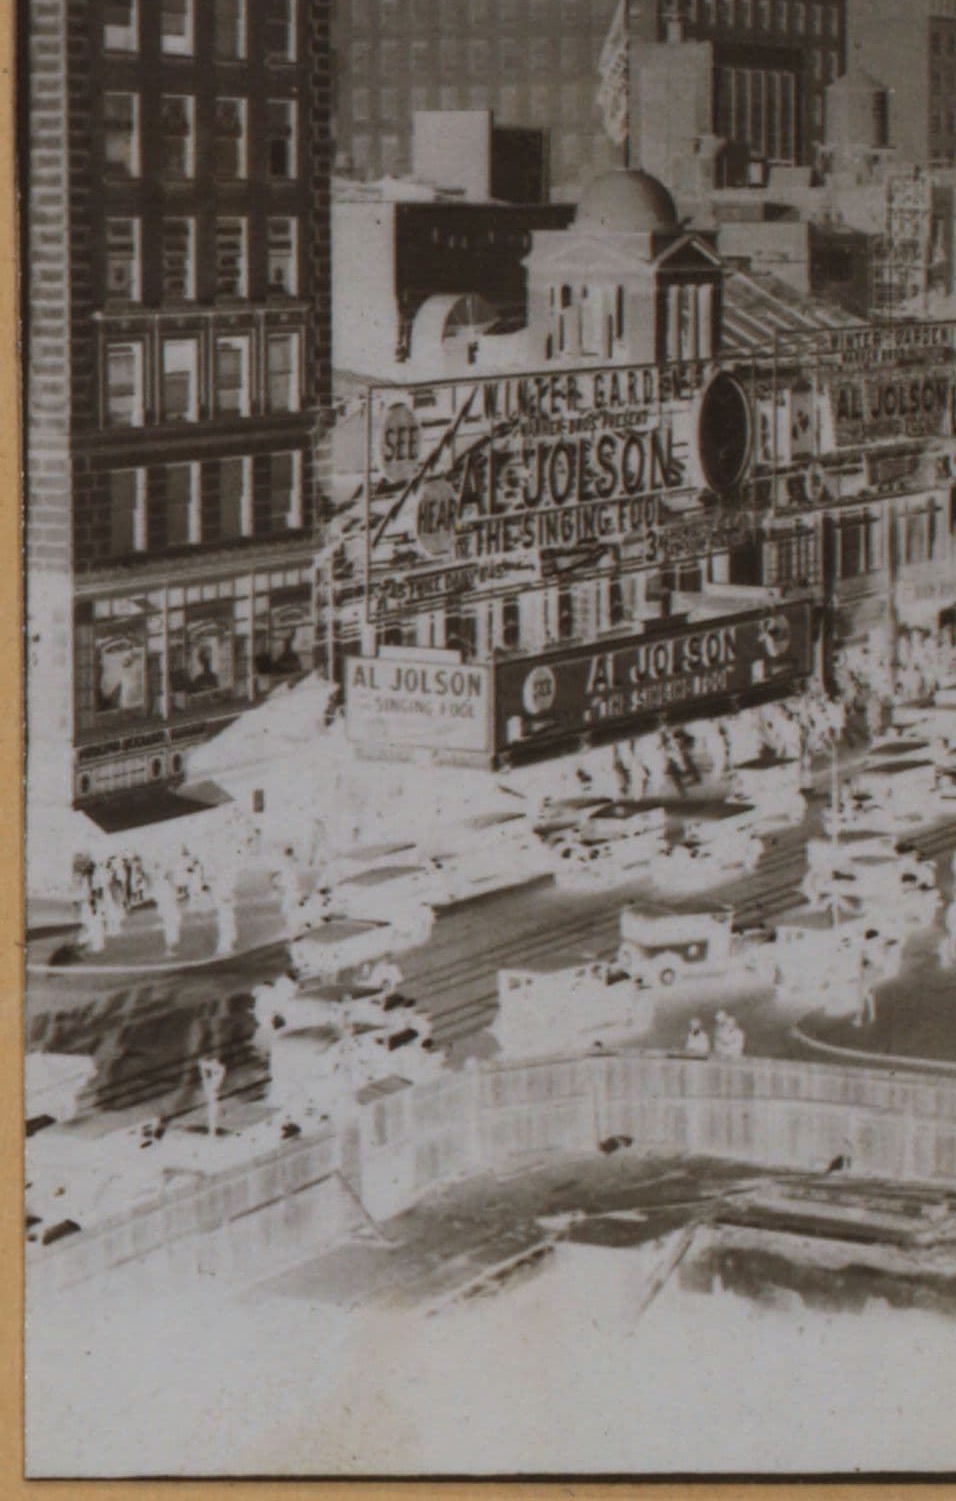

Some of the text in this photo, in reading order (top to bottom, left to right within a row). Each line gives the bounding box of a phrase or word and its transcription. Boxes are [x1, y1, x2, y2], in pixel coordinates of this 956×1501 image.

[484, 374, 581, 421] WINTER
[836, 379, 948, 420] AL JOLSON
[384, 424, 420, 463] SEE
[523, 428, 676, 510] JOLSON
[523, 502, 613, 549] SINGING
[630, 627, 737, 683] JOLSON
[352, 664, 482, 697] AL JOLSON
